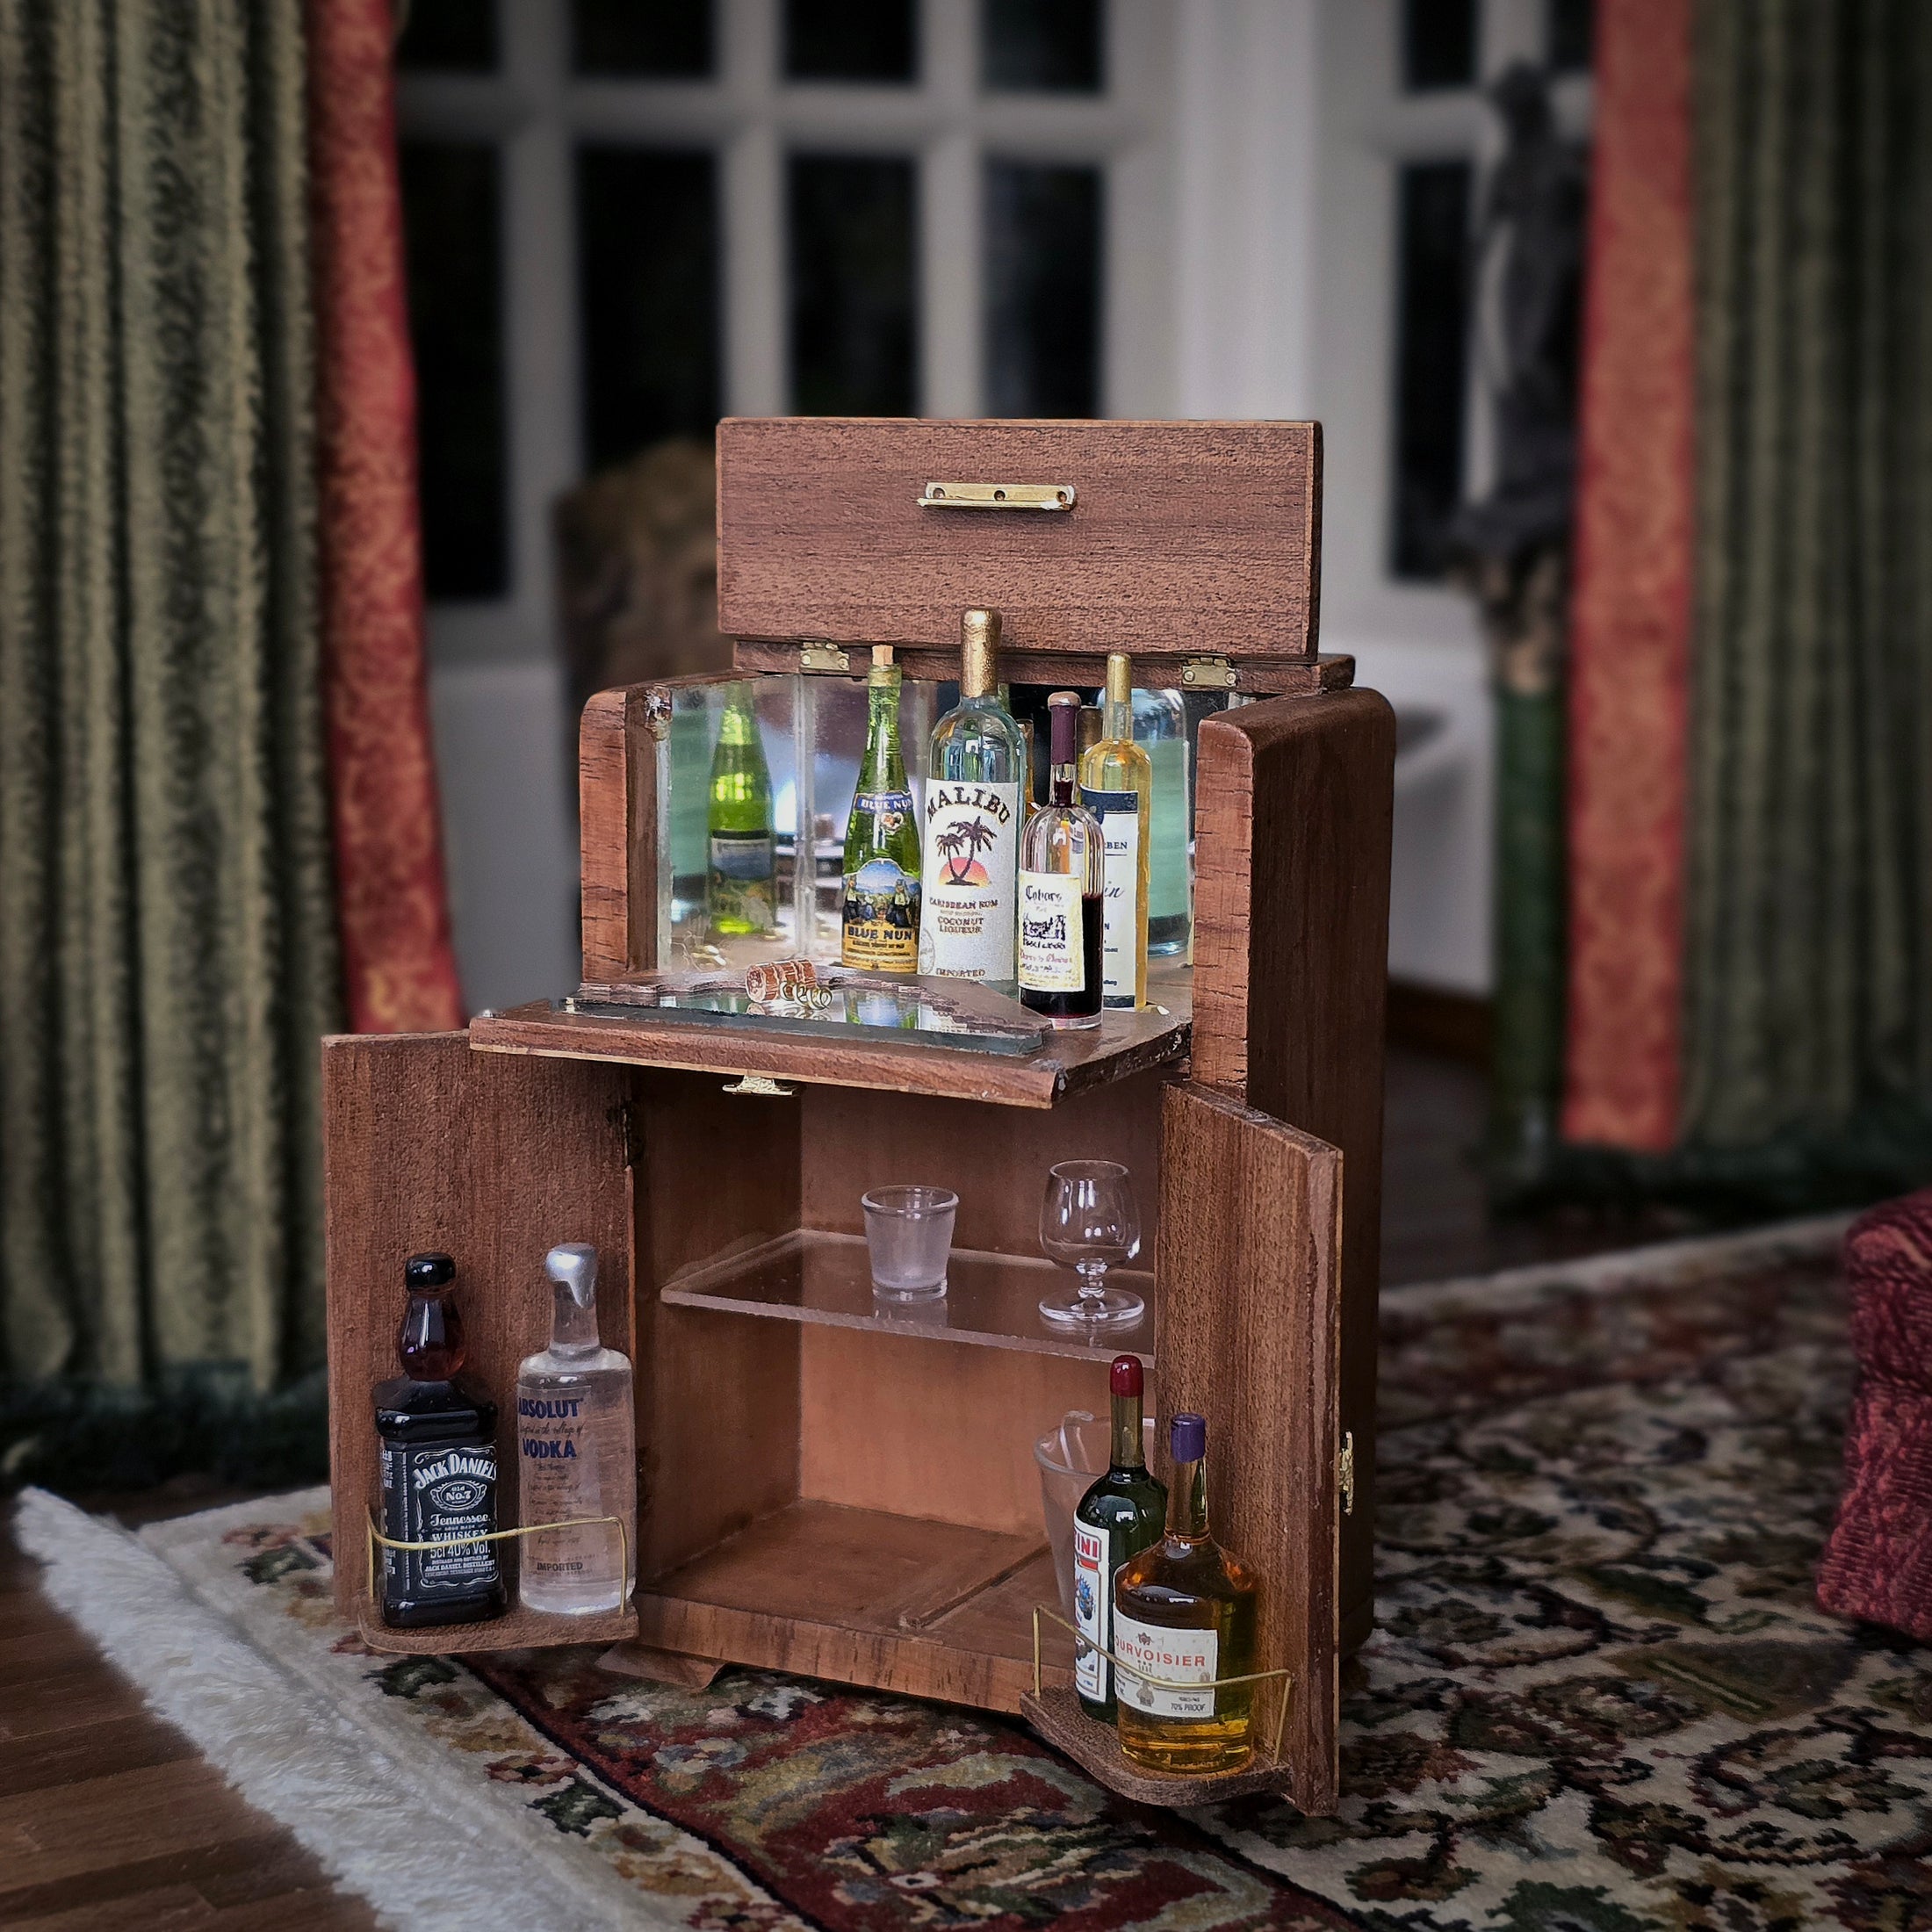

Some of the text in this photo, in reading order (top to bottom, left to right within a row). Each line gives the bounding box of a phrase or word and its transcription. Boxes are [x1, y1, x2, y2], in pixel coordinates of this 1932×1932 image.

[927, 787, 1011, 824] MALIBU
[937, 916, 984, 926] COCONUT
[847, 926, 912, 941] BLUE NUN
[523, 1438, 577, 1459] VODKA
[413, 1460, 448, 1489] JACK
[431, 1528, 488, 1543] WHISKEY
[447, 1543, 471, 1557] 40%
[1074, 1531, 1098, 1559] INI
[537, 1561, 584, 1572] IMPORTED
